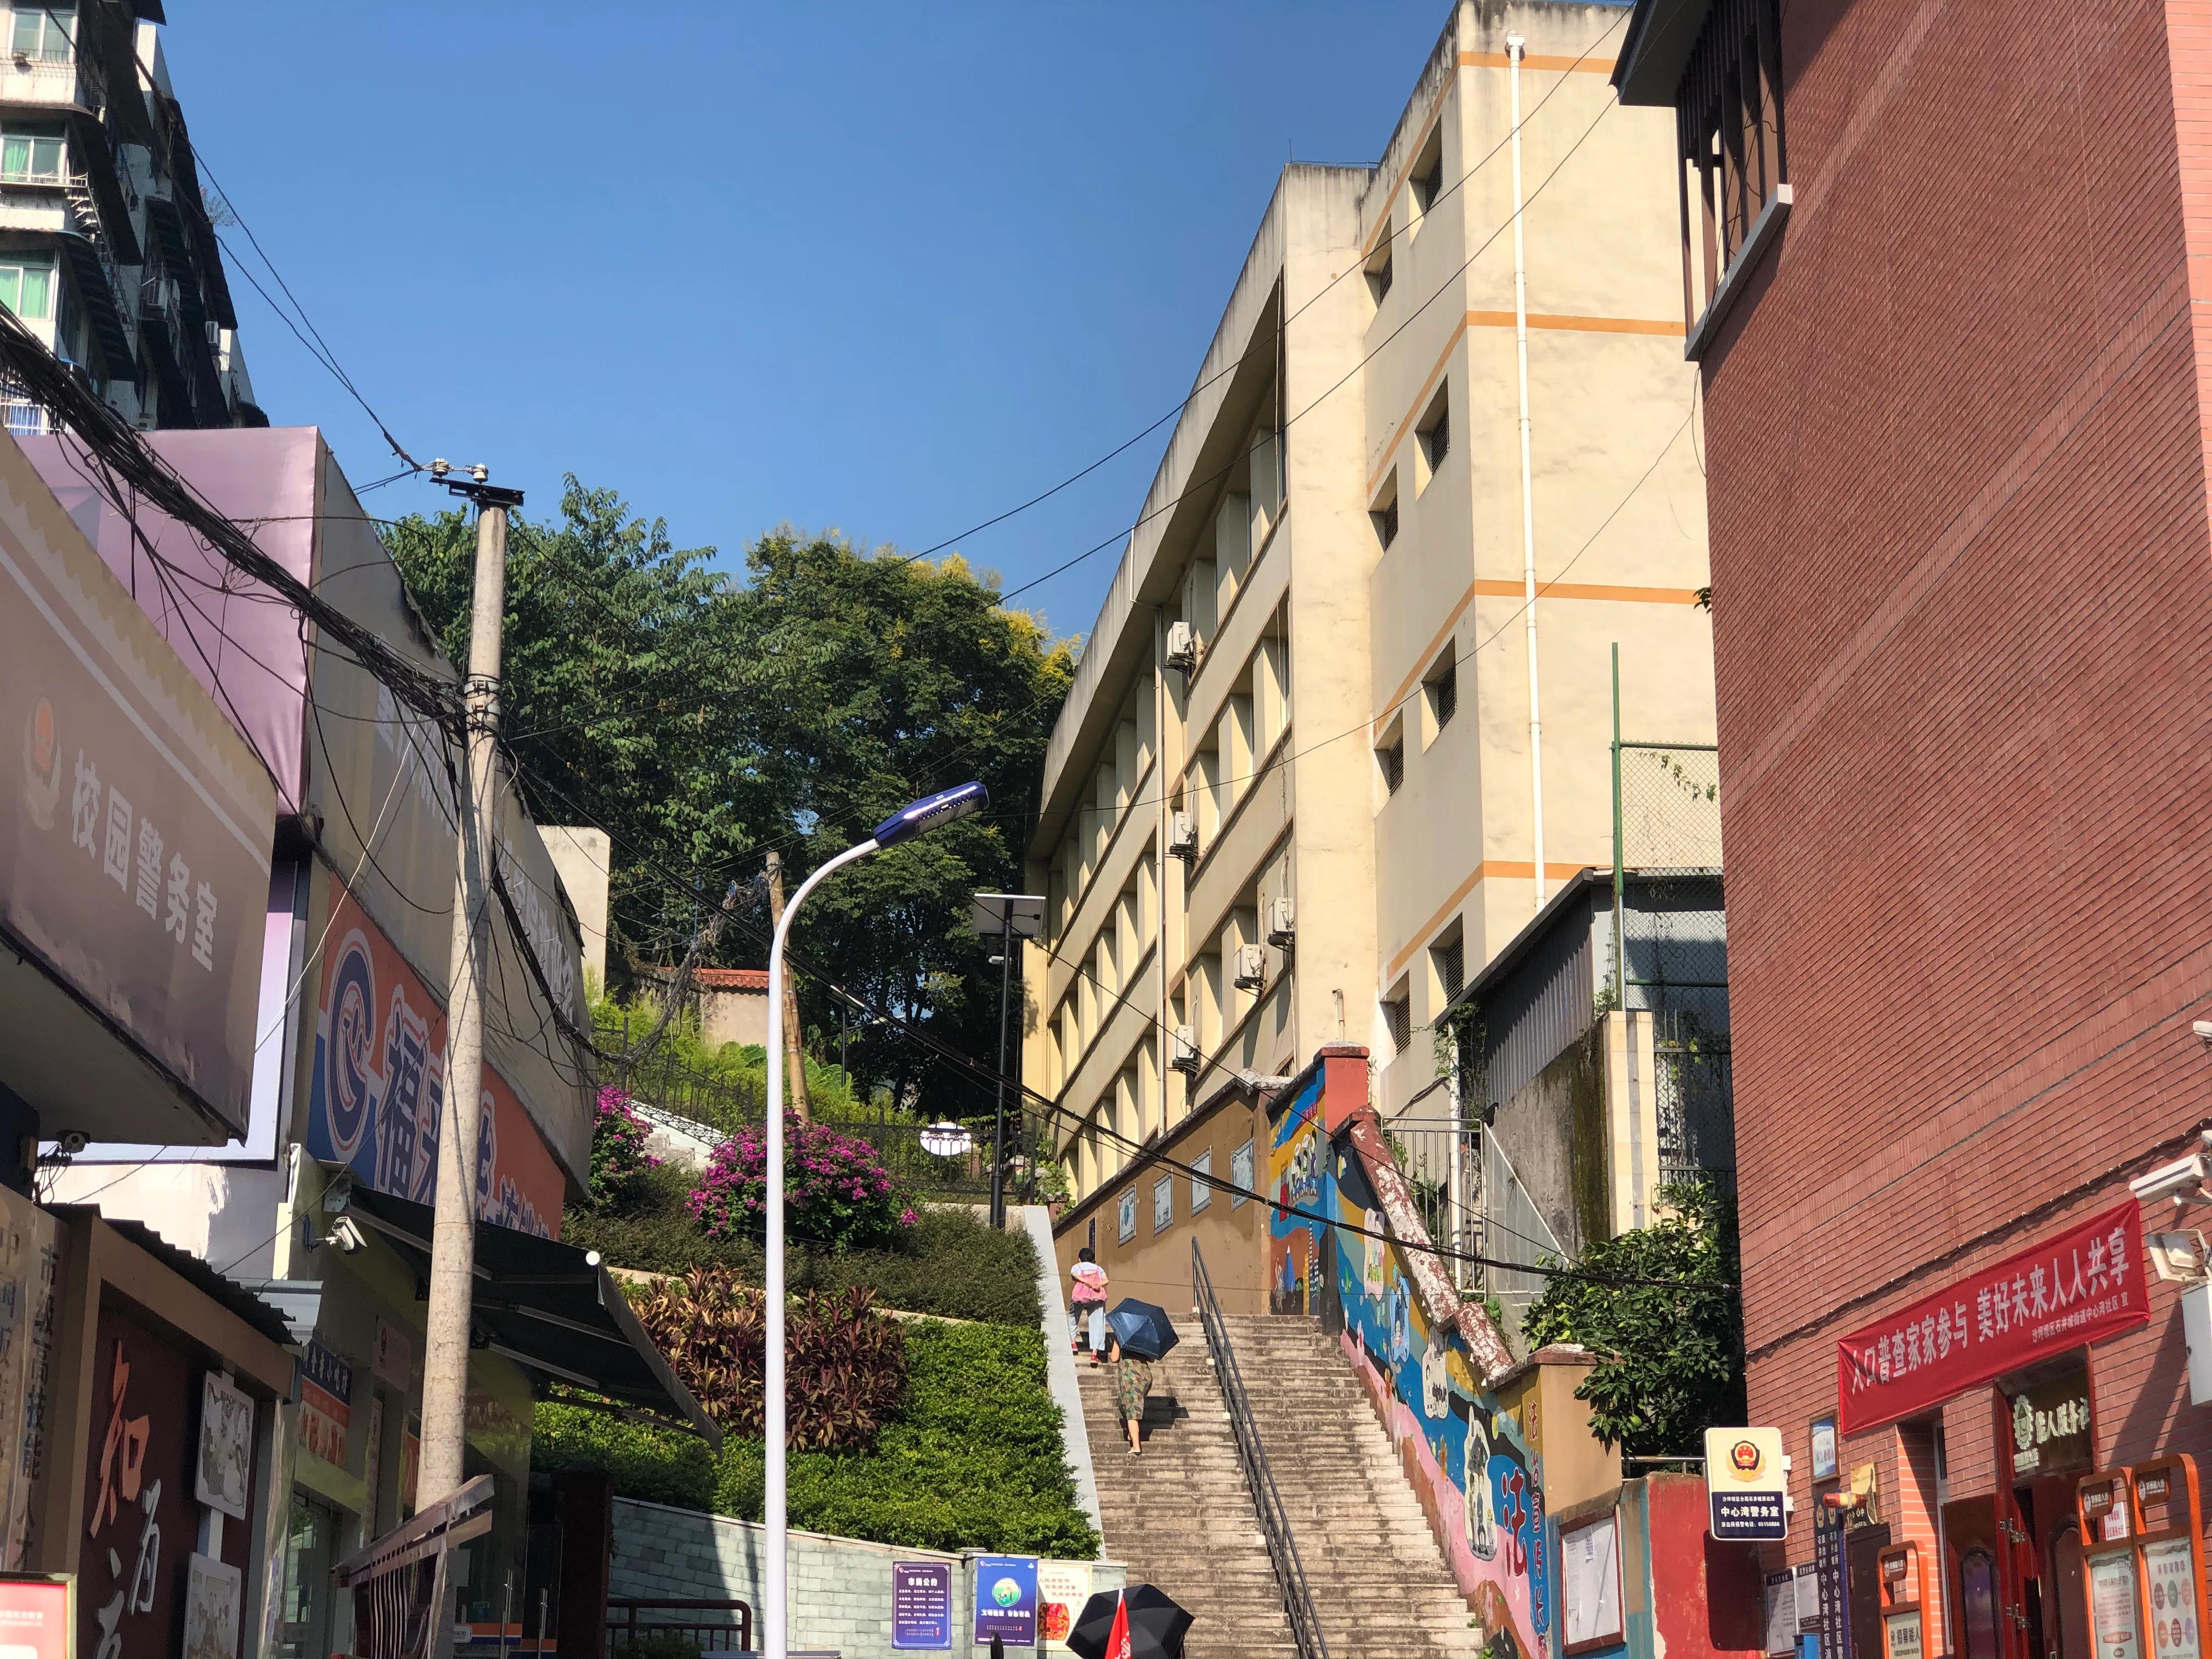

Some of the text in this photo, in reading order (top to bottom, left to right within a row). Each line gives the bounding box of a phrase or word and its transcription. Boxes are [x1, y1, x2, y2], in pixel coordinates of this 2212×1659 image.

[71, 747, 218, 973] 校园警务室
[1852, 1227, 2130, 1395] 人口普查家家参与 美好未来人人共享
[1501, 1466, 1528, 1578] 法
[1720, 1506, 1779, 1517] 中心湾警务室
[908, 1577, 938, 1587] 市民公约
